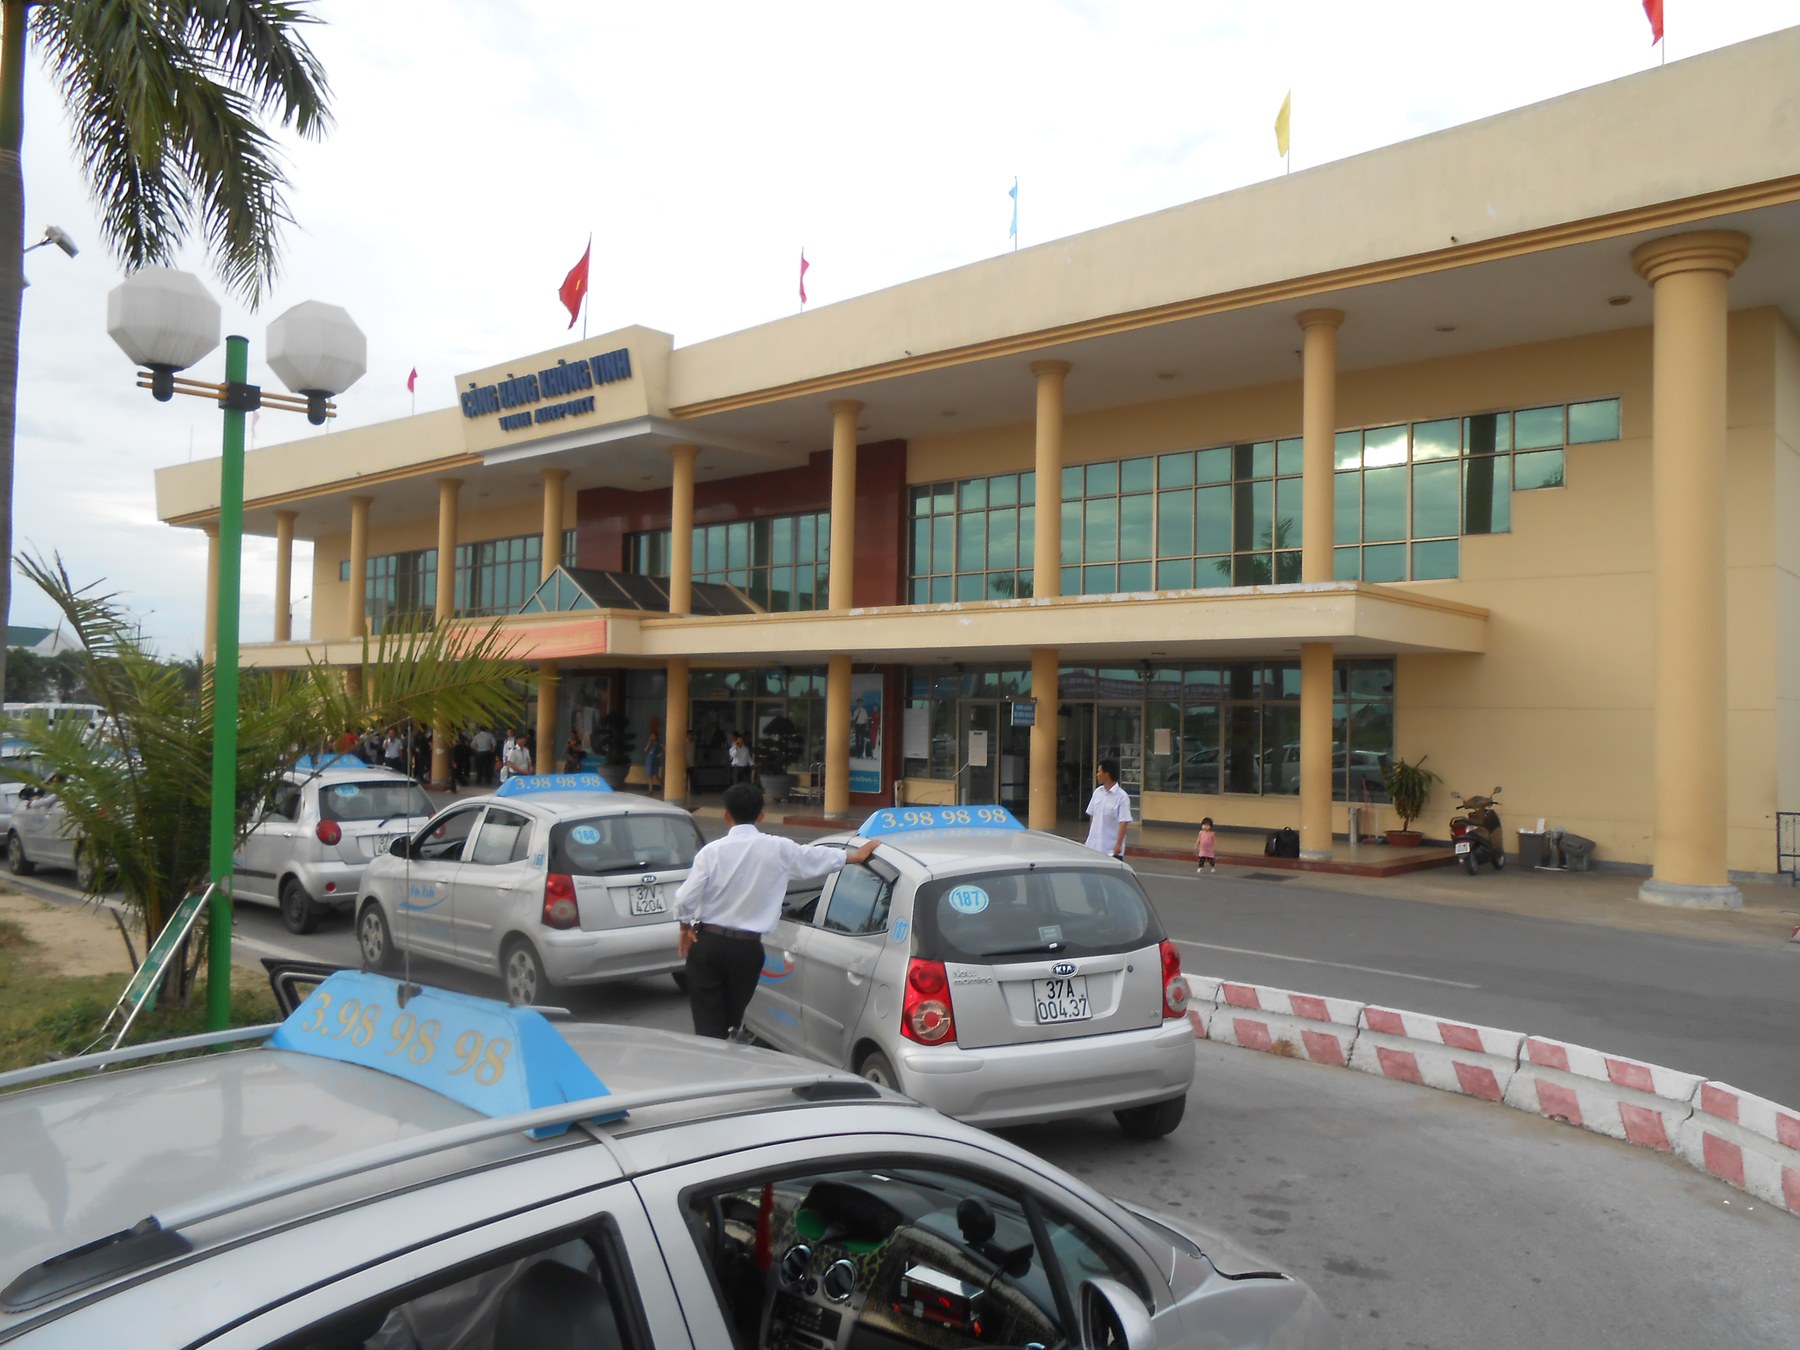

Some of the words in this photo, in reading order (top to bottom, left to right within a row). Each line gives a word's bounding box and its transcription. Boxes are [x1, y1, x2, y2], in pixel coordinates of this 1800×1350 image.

[589, 348, 632, 385] VINH
[499, 411, 532, 431] VINH
[534, 395, 595, 424] AIRPORT
[515, 776, 551, 790] 3.98
[556, 776, 577, 788] 98
[580, 775, 601, 787] 98
[881, 811, 935, 829] 3.98
[941, 809, 971, 825] 98
[977, 808, 1007, 824] 98
[636, 900, 663, 913] 4204
[955, 890, 980, 908] 187
[1053, 964, 1077, 976] KIA
[1046, 979, 1075, 999] 37A
[1038, 998, 1088, 1020] 004.37
[303, 992, 381, 1047] 3.98
[383, 1012, 442, 1065] 98
[447, 1029, 512, 1087] 98
